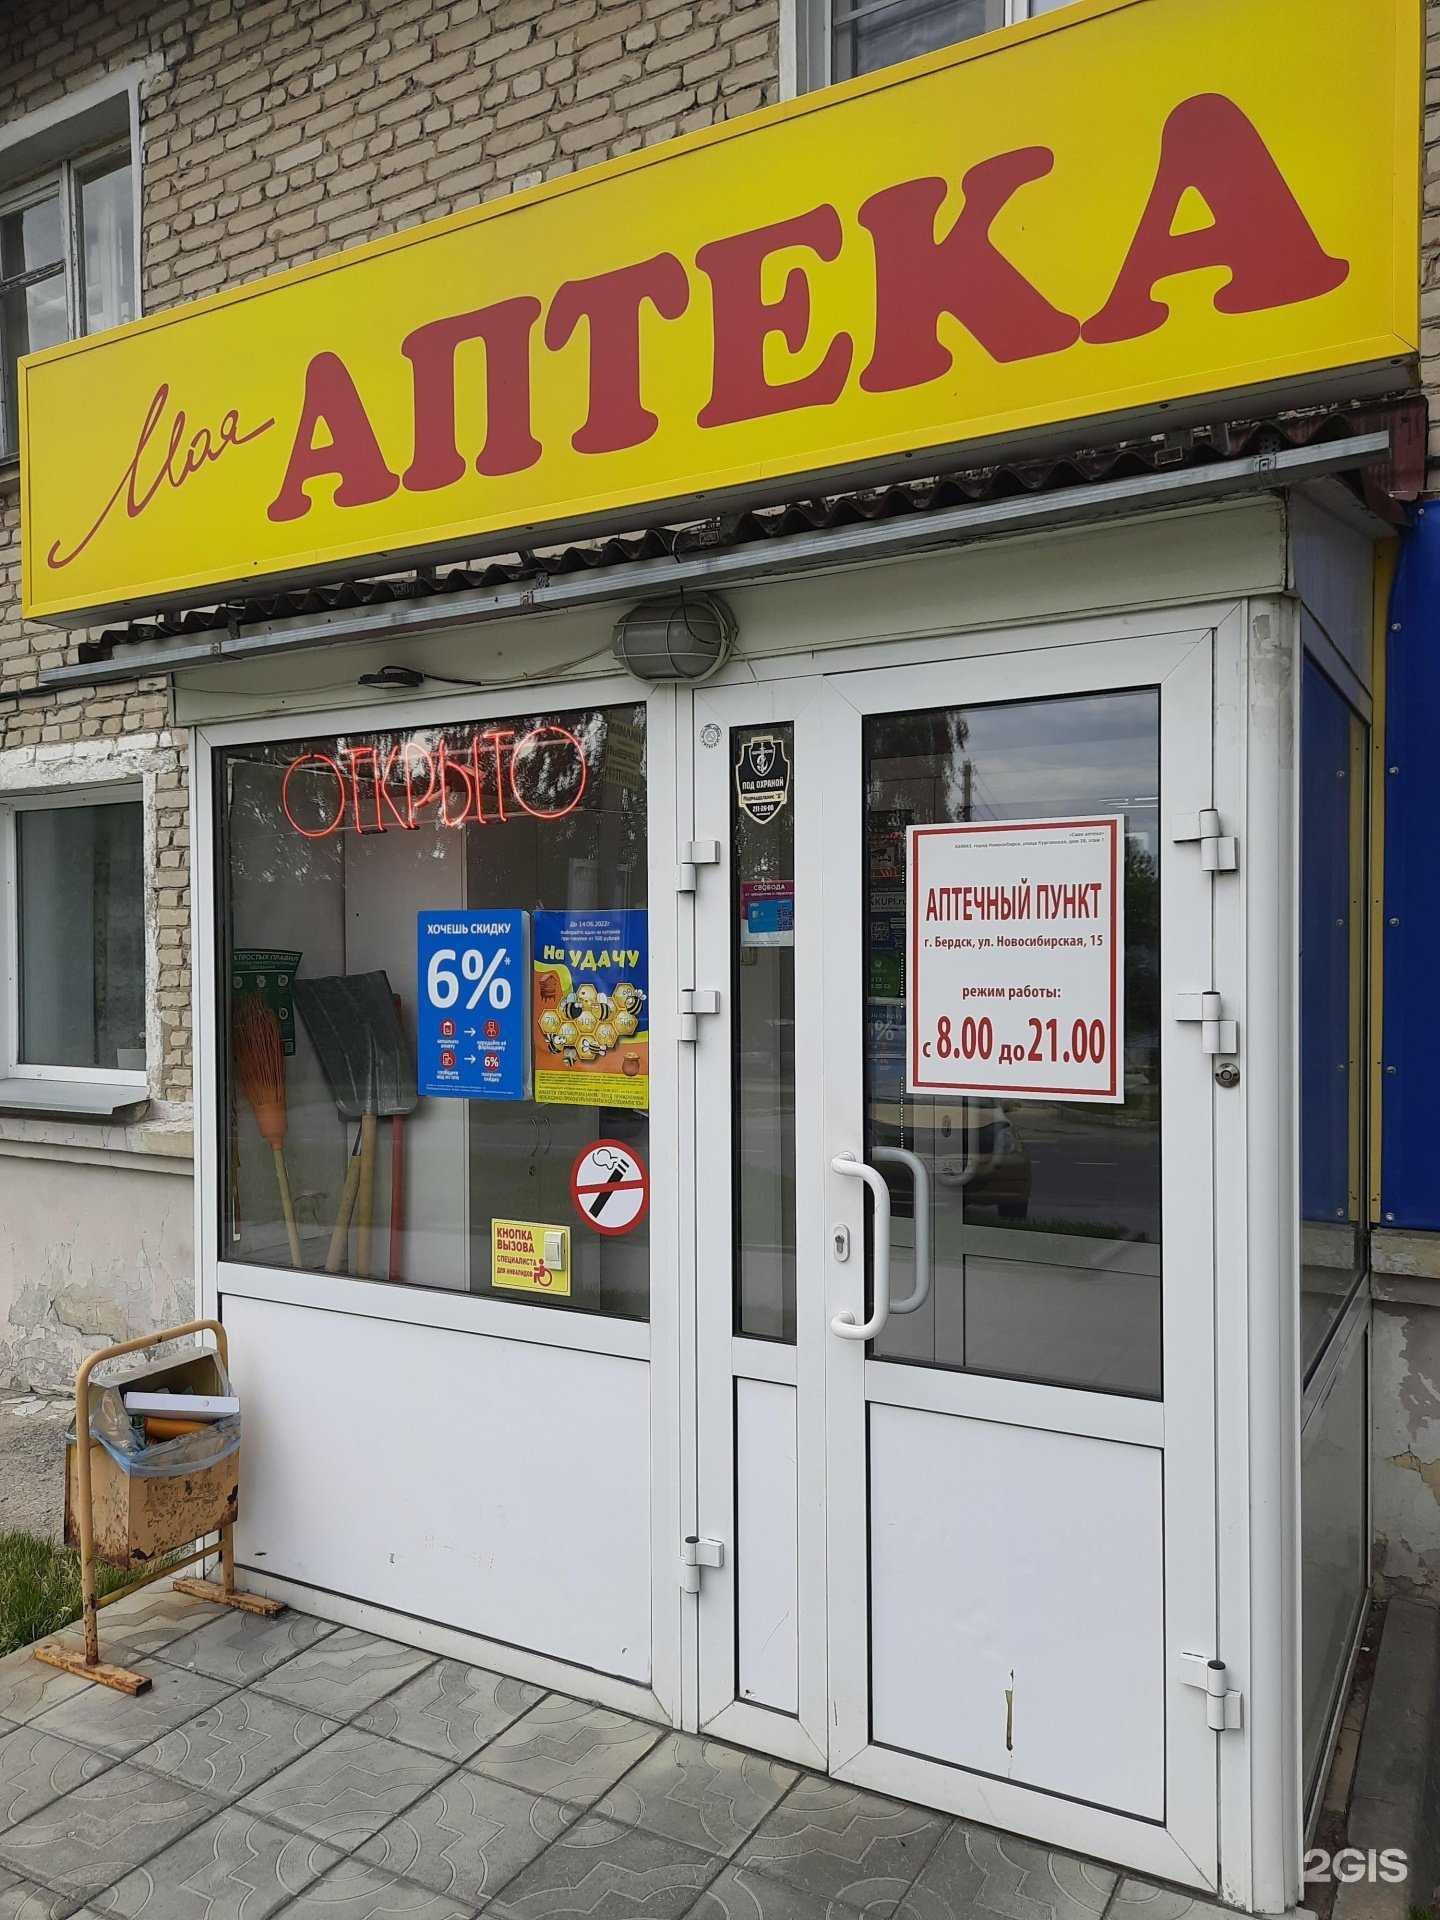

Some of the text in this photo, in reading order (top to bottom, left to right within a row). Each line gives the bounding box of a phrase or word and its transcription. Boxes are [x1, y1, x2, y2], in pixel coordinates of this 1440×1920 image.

[47, 92, 1350, 569] Моя АПТЕКА
[282, 726, 586, 837] ОТКРЫТО
[742, 777, 784, 790] ПОД ОХРАНОЙ
[926, 878, 1102, 922] АПТЕЧНЫЙ ПУНКТ
[427, 922, 511, 936] ХОЧЕШЬ СКИДКУ
[924, 935, 1103, 950] г. Бердск, ул. Новосибирская, 15
[543, 944, 640, 971] На УДАЧУ
[962, 985, 1061, 1000] режим работы:
[922, 1015, 1106, 1065] с 8.00 до 21.00
[484, 1056, 499, 1067] 6%
[496, 1227, 533, 1241] КНОПКА
[496, 1239, 535, 1253] ВЫЗОВА
[496, 1255, 537, 1266] СПЕЦИАЛИСТА
